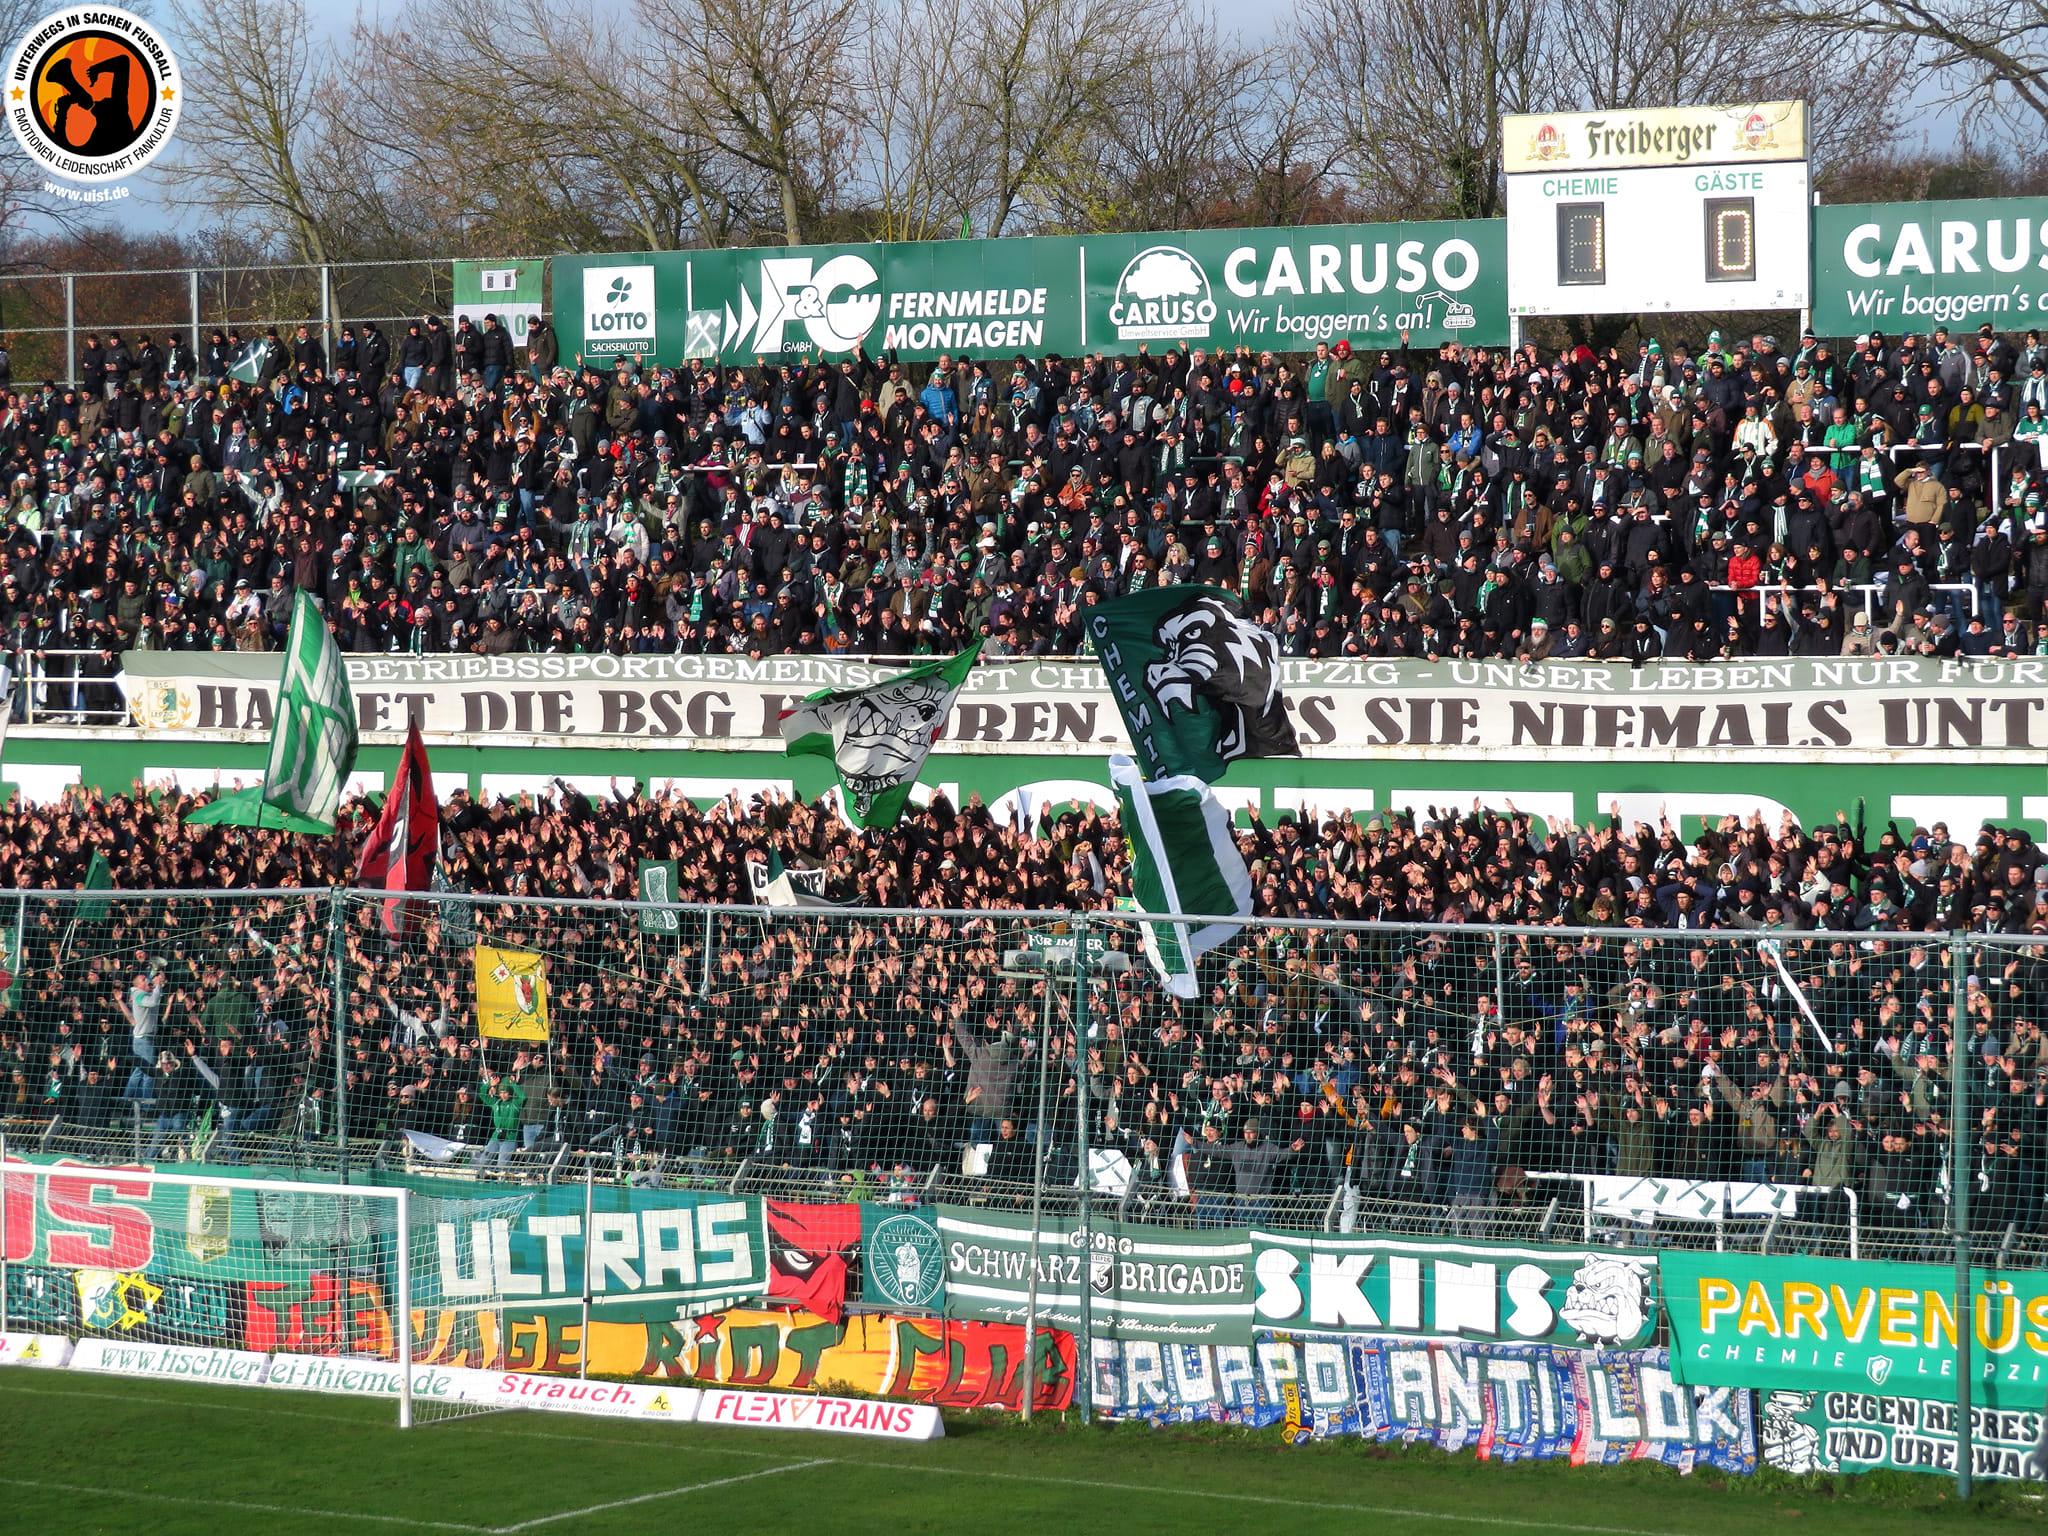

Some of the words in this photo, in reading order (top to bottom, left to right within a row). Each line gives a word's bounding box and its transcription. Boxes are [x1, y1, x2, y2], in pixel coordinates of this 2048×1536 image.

[1585, 120, 1717, 160] Freiberger
[1542, 177, 1618, 197] CHEMIE
[1695, 170, 1764, 192] GÄSTE
[1223, 238, 1480, 298] CARUSO
[889, 287, 1048, 319] FERNMELDE
[1109, 299, 1217, 326] CARUSO
[1846, 289, 1896, 316] Wir
[1902, 283, 2029, 322] baggern's
[591, 312, 648, 331] LOTTO
[886, 319, 1044, 351] MONTAGEN
[1180, 326, 1207, 336] GmbH
[1226, 308, 1270, 334] Wir
[1275, 304, 1388, 340] baggern's
[1395, 303, 1433, 330] an!
[591, 341, 649, 353] SACHSENLOTTO
[782, 341, 813, 353] GMBH
[1451, 662, 1615, 691] UNSER
[1629, 664, 1794, 691] LEBEN
[1812, 660, 1935, 686] NUR
[1938, 657, 2048, 685] FÜR
[197, 684, 435, 732] HAET
[461, 690, 575, 734] DIE
[598, 689, 736, 737] BSG
[1366, 696, 1479, 747] SIE
[1509, 699, 1853, 747] NIEMALS
[1878, 697, 2048, 748] UNT
[1056, 938, 1105, 952] IMER
[437, 1202, 754, 1297] ULTRAS
[1120, 1261, 1245, 1295] BRIGADE
[1255, 1248, 1556, 1338] SKINS
[641, 1315, 848, 1389] RIOT
[1698, 1344, 1846, 1367] CHEMIE
[1918, 1358, 2040, 1381] LEPZI
[498, 1374, 636, 1405] Strauch.
[1090, 1337, 1350, 1406] GRUPPO
[1388, 1346, 1557, 1435] ANTI
[1825, 1391, 1919, 1429] GEGEN
[1827, 1429, 1886, 1461] UND
